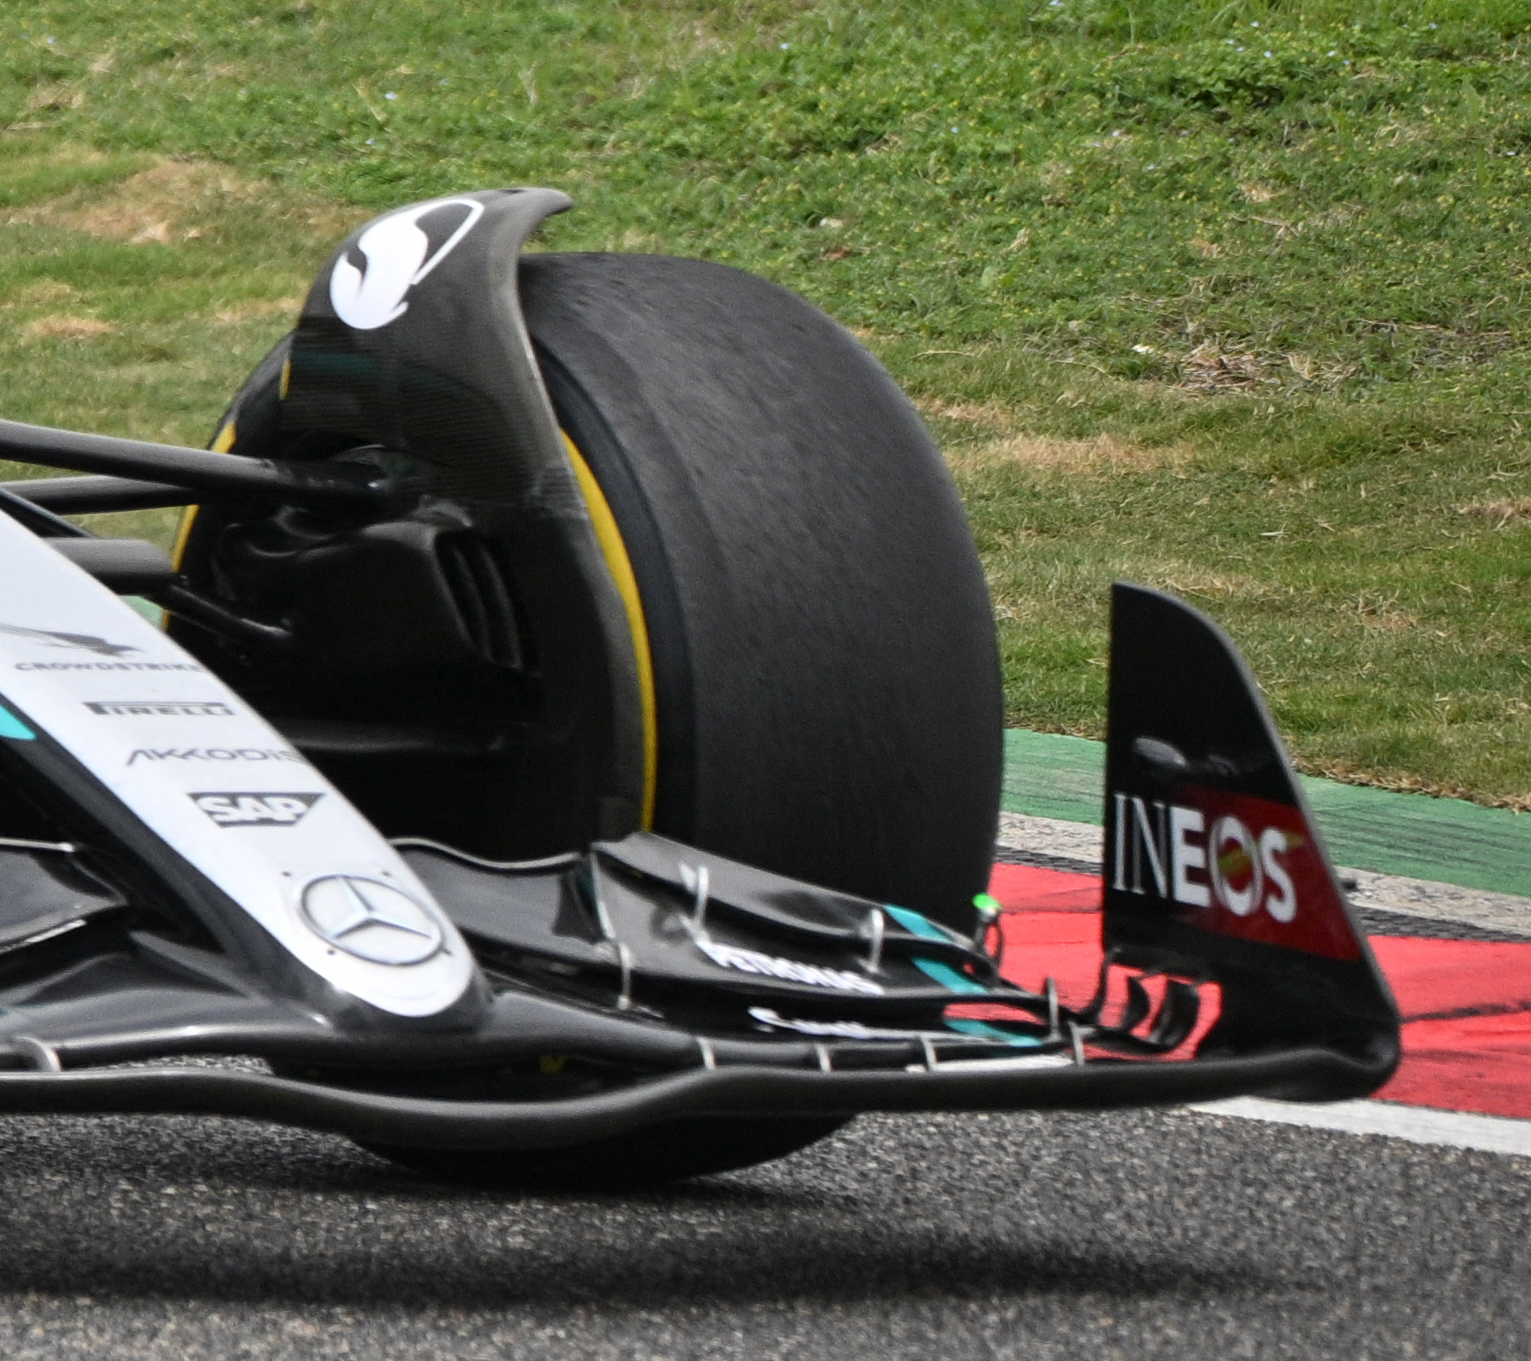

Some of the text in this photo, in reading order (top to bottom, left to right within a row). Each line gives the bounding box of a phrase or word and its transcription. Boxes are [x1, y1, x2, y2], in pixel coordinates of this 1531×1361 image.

[14, 661, 209, 673] CROWDSTRIKE
[82, 700, 235, 716] PIRELLI
[193, 795, 315, 825] SAP
[1113, 791, 1298, 923] INEOS
